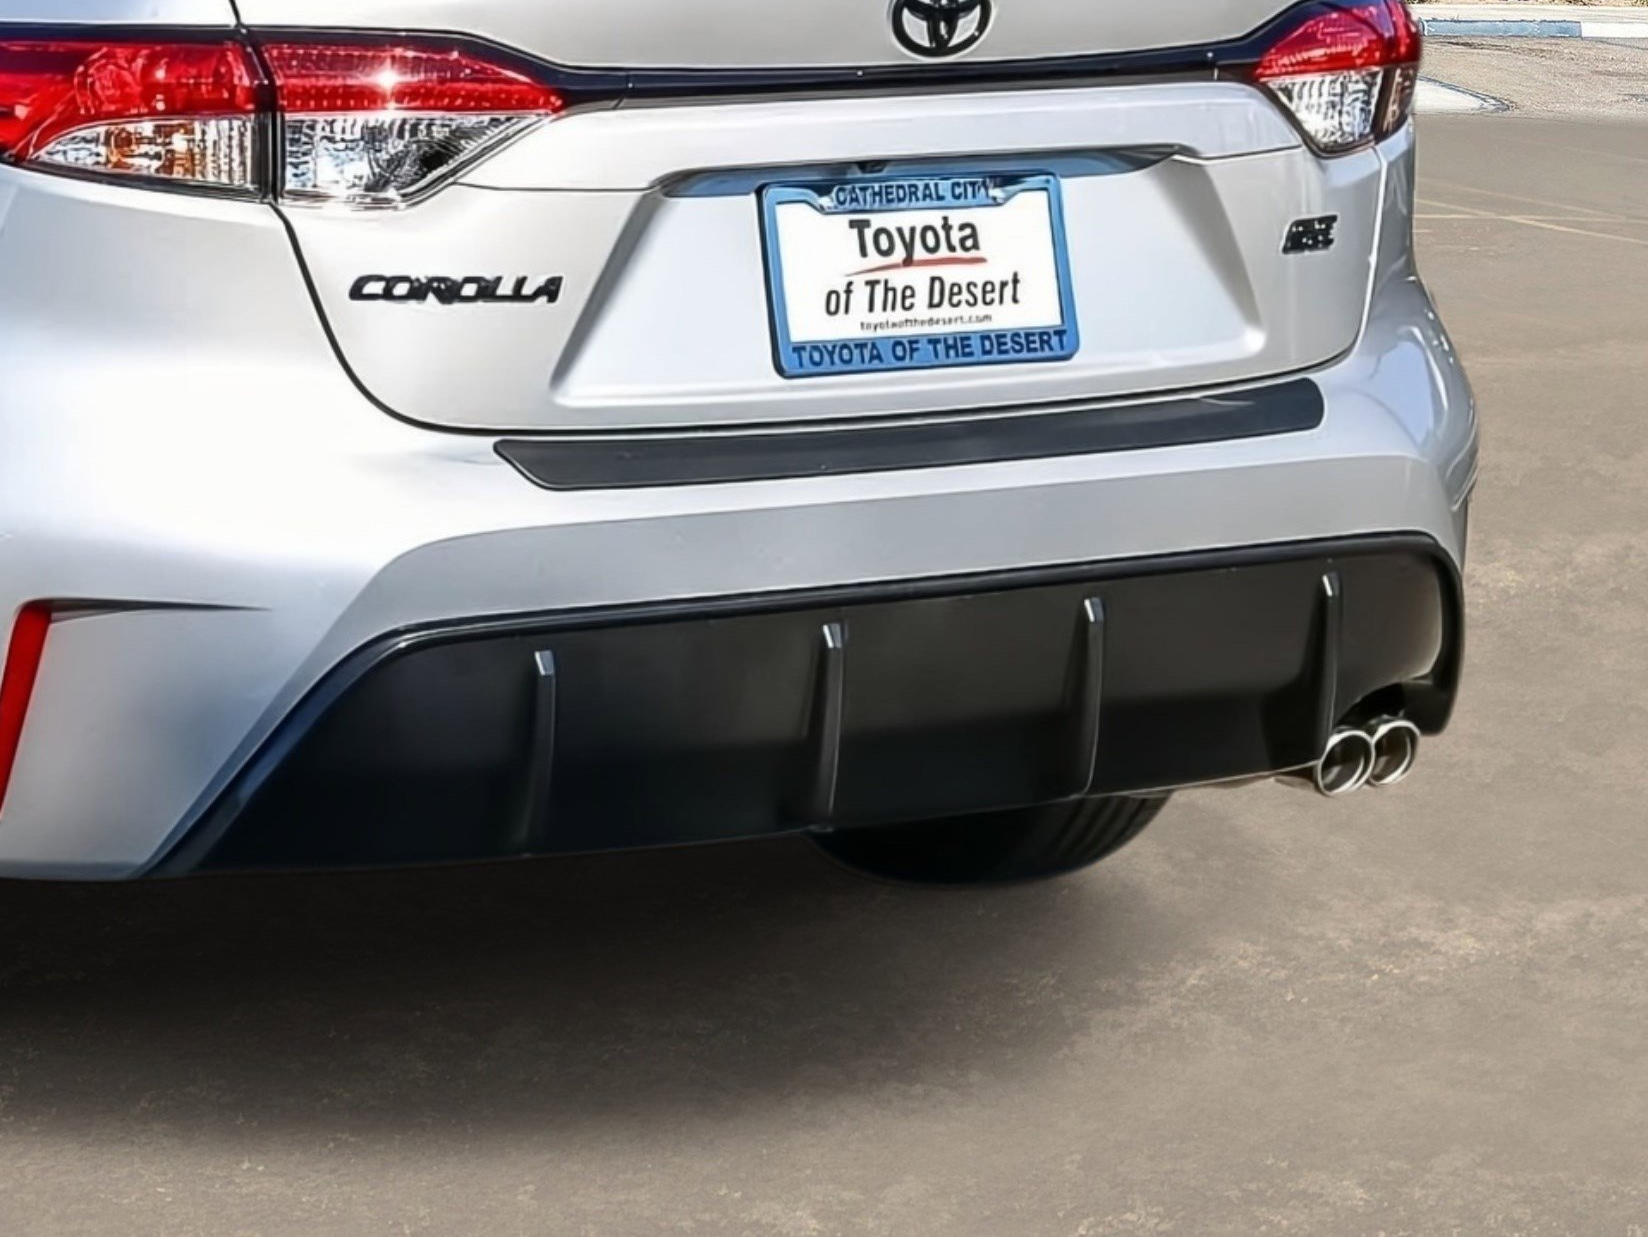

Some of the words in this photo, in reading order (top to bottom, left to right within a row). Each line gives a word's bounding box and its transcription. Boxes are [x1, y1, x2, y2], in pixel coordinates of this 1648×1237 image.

[835, 182, 946, 206] CATHEDRAL
[952, 177, 990, 200] CITY
[849, 216, 981, 266] Toyota
[349, 274, 563, 304] COROLLA
[825, 282, 854, 316] of
[865, 279, 915, 313] The
[928, 272, 1021, 309] Desert
[792, 343, 881, 369] TOYOTA
[891, 339, 921, 363] OF
[927, 335, 975, 362] THE
[980, 329, 1068, 356] DESERT
